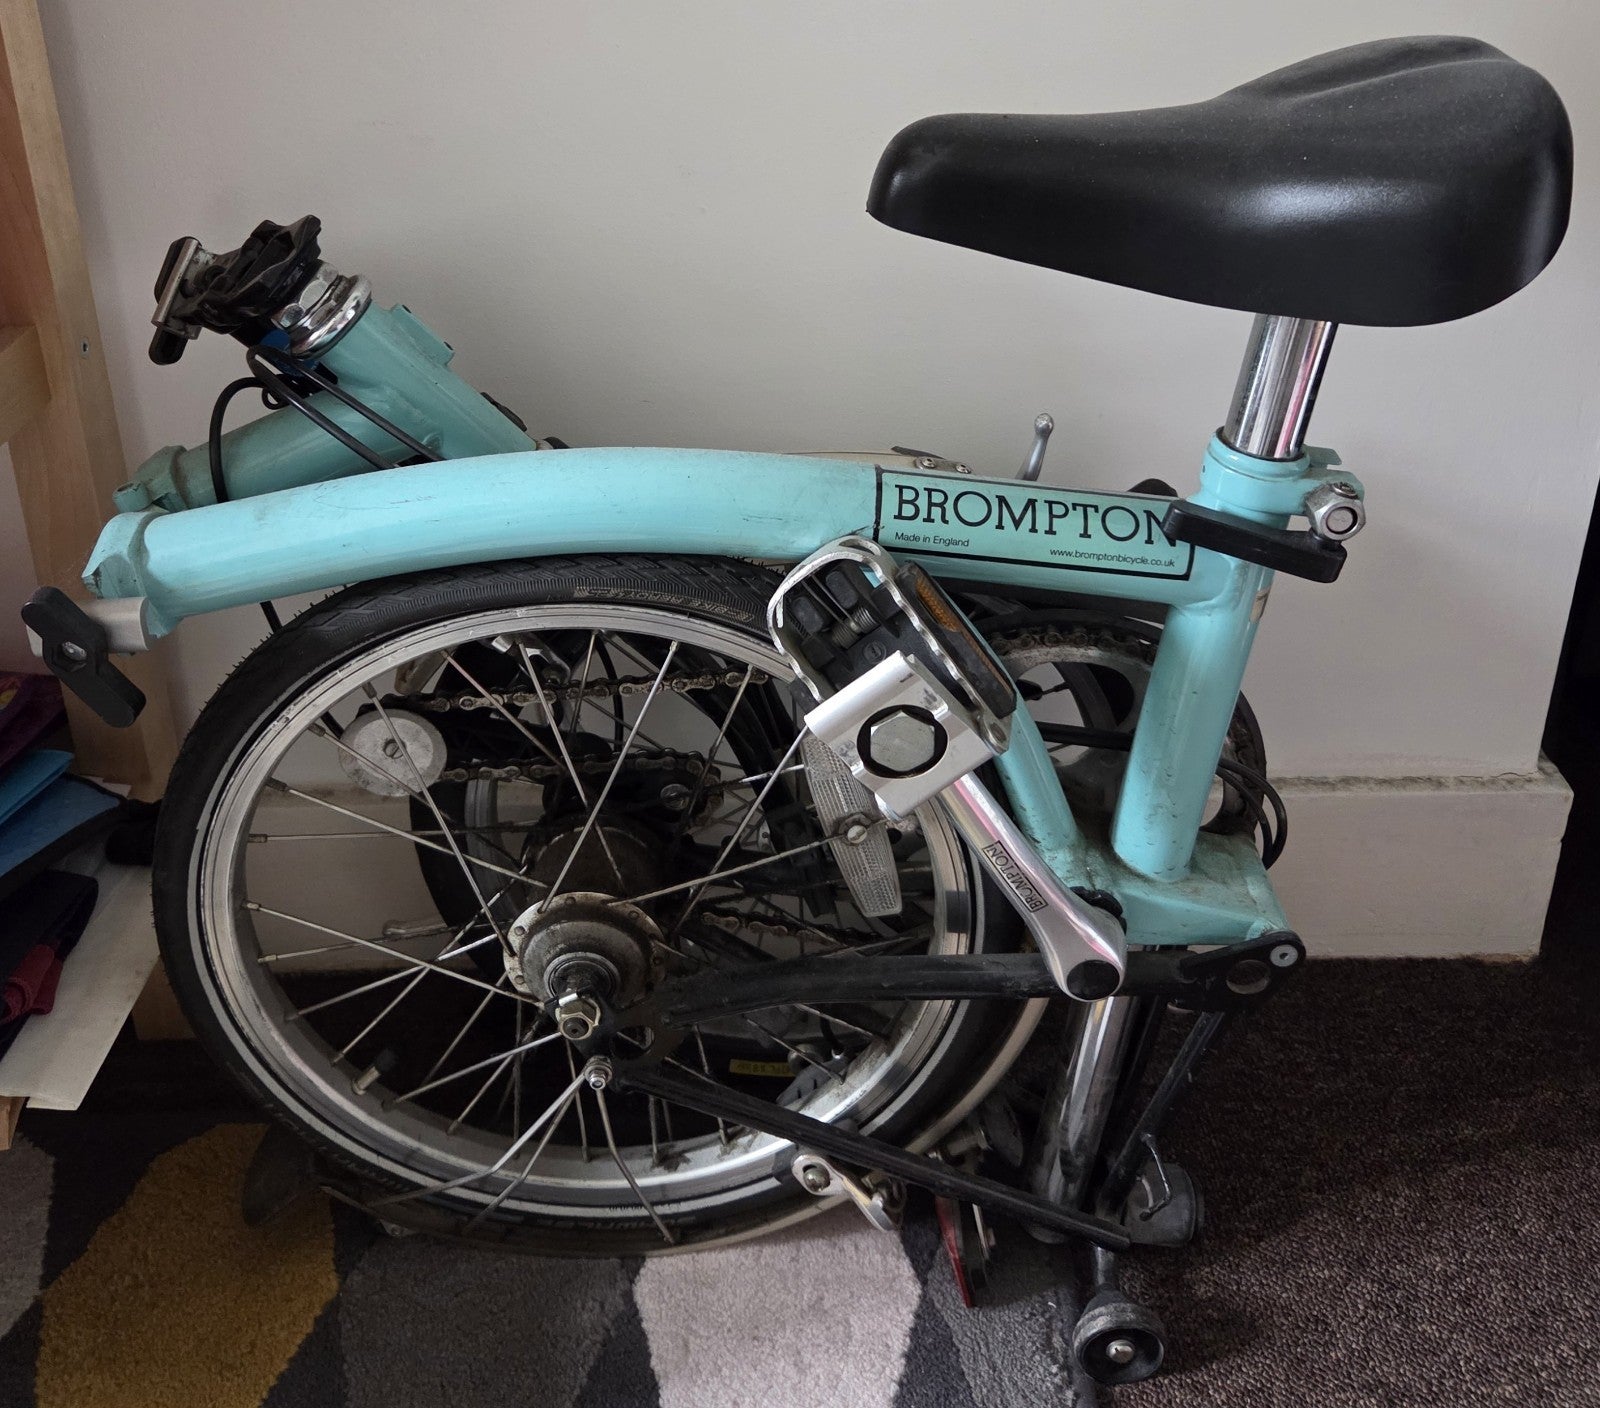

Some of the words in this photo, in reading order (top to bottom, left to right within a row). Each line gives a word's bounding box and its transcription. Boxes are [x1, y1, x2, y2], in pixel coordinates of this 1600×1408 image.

[893, 484, 1178, 547] BROMPTON
[895, 531, 921, 544] Made
[922, 534, 931, 545] in
[933, 535, 970, 548] England
[1049, 548, 1175, 568] www.bromptonbicycle.co.uk
[987, 844, 1043, 910] BROMPTON
